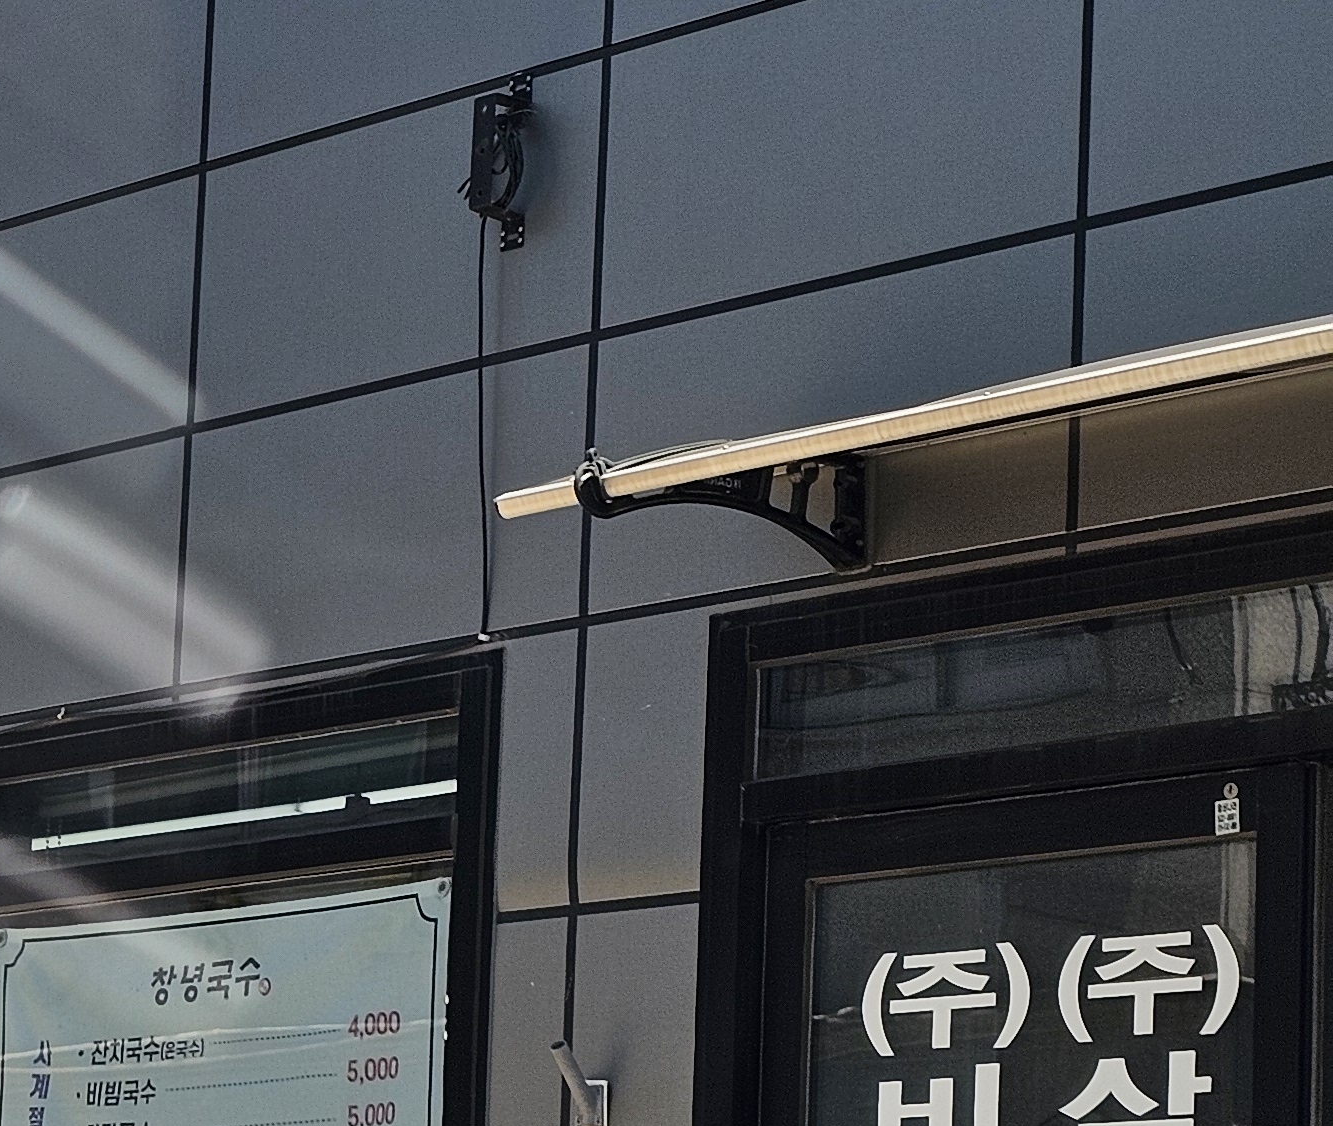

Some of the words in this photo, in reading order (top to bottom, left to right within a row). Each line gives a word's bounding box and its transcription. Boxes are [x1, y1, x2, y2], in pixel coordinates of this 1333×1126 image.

[151, 957, 262, 1006] 창녕국수
[348, 1010, 401, 1036] 4,000
[86, 1079, 157, 1107] 비빔국수
[347, 1056, 400, 1085] 5,000
